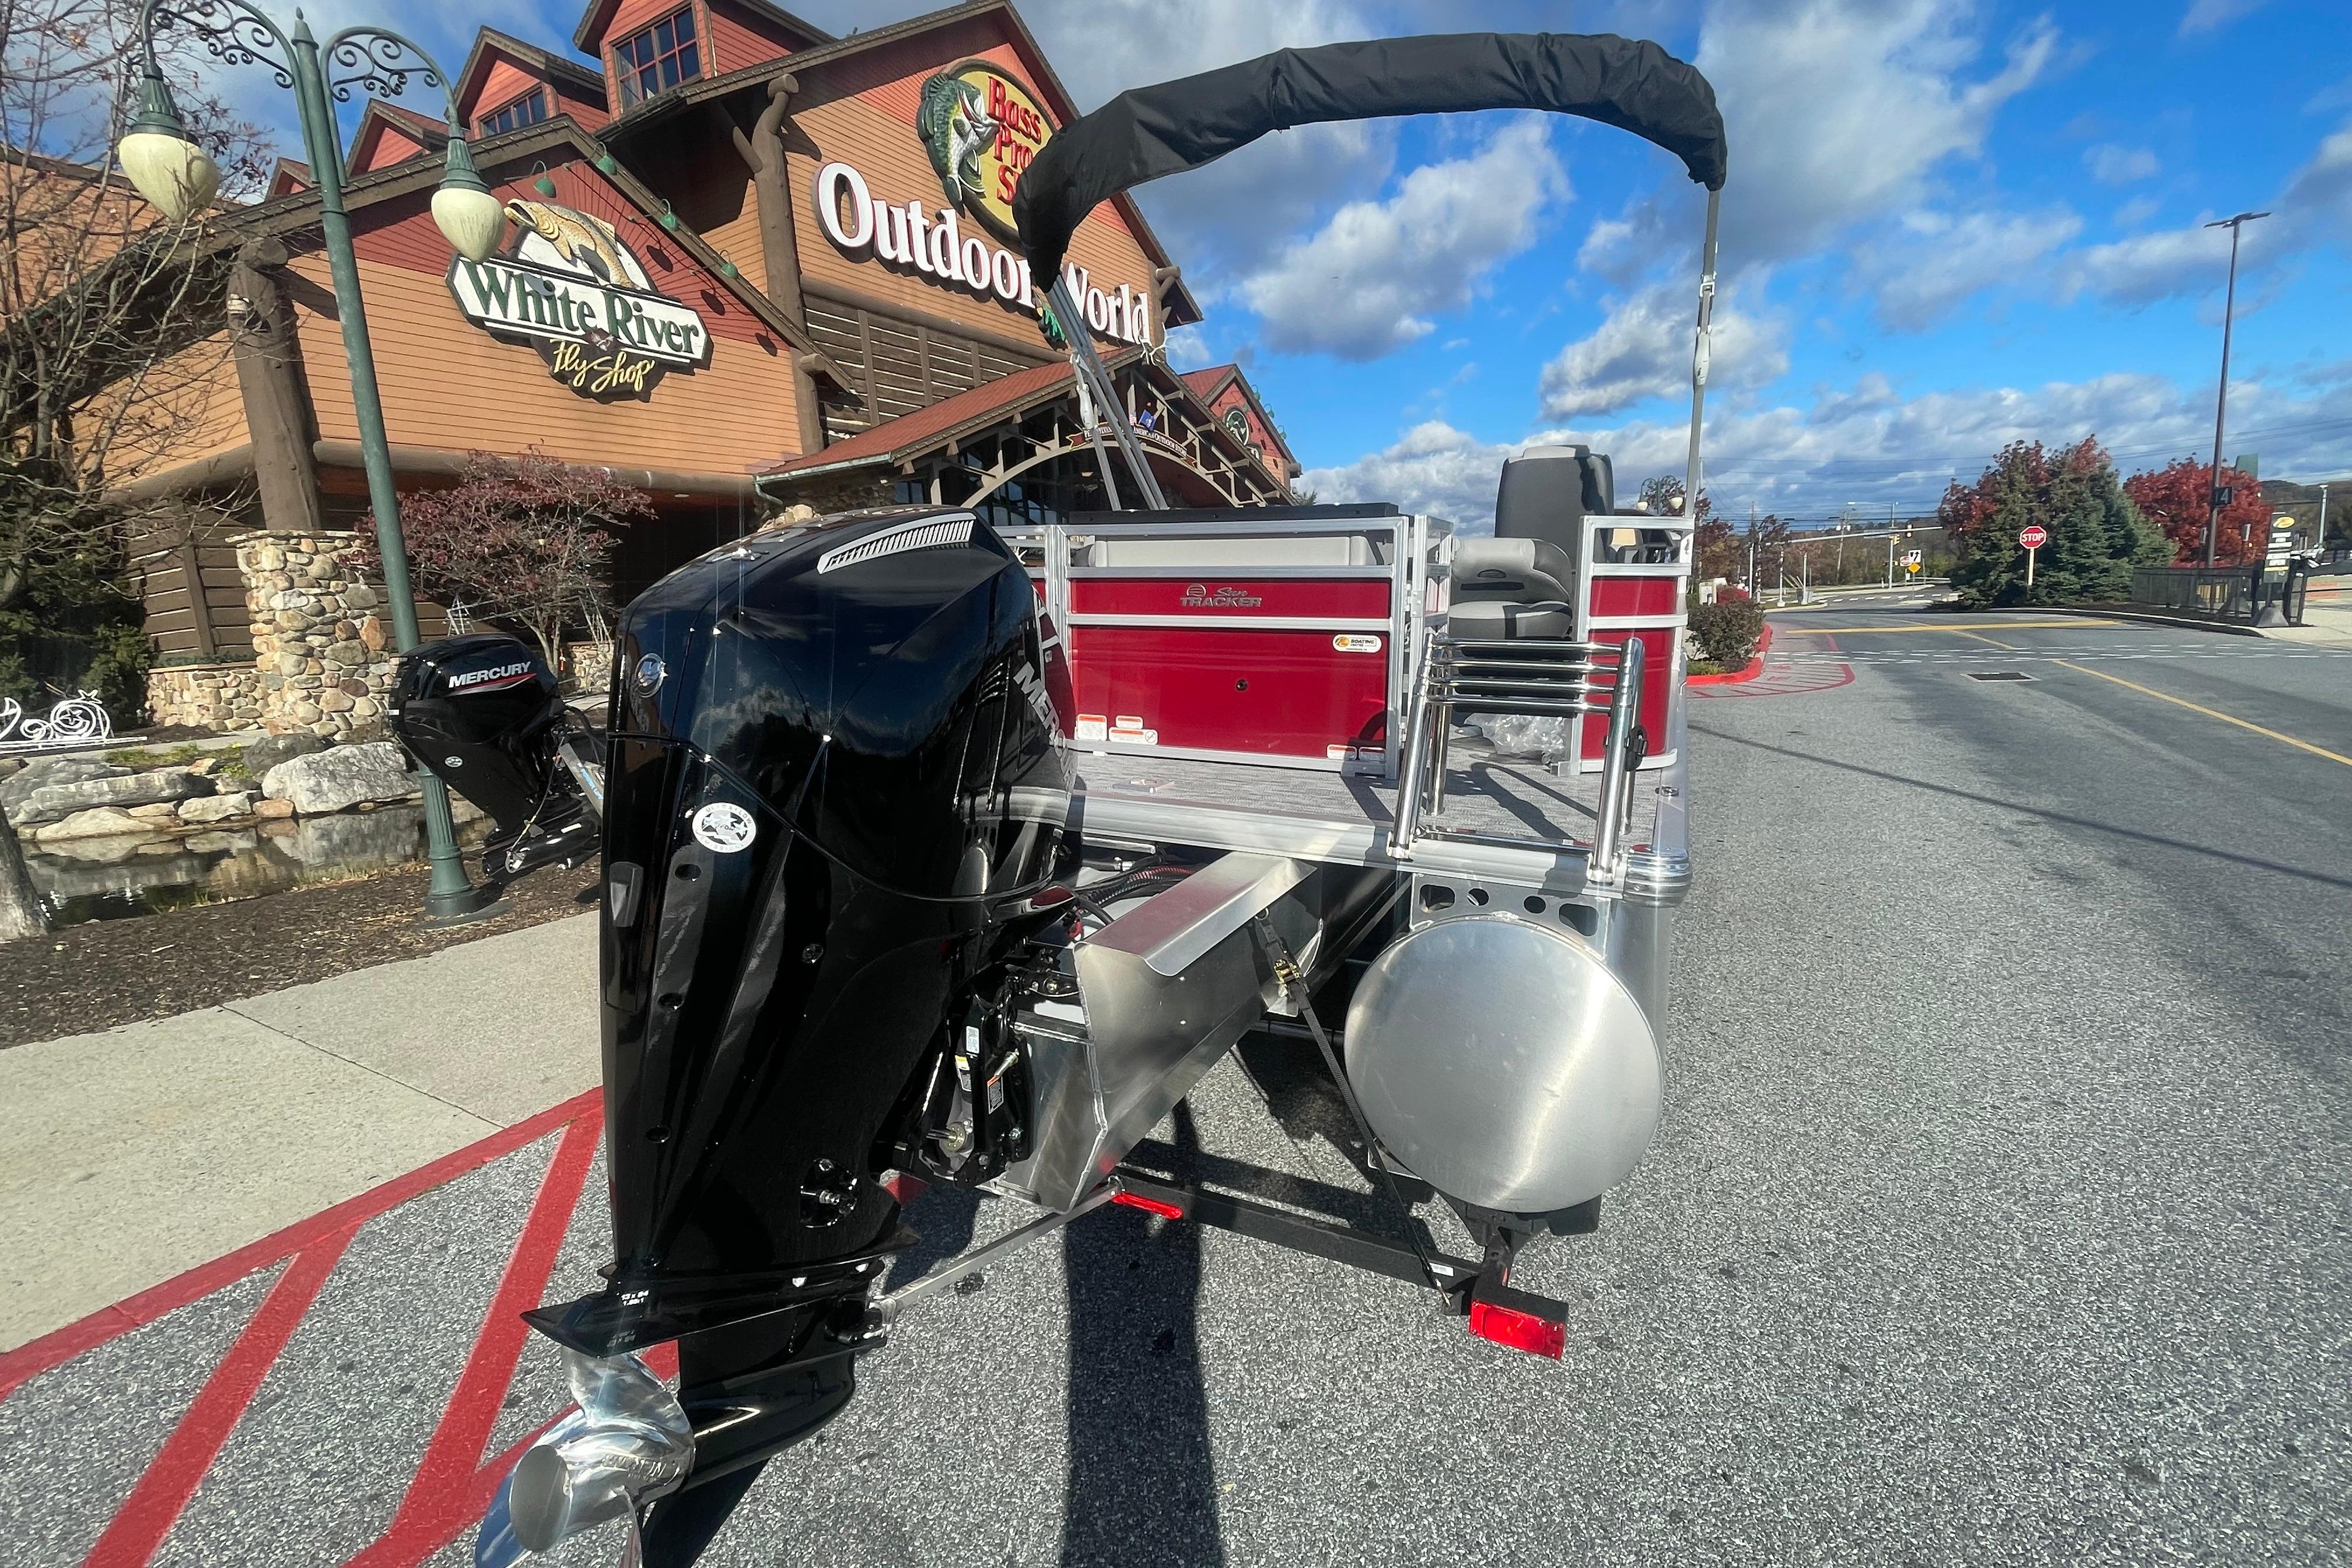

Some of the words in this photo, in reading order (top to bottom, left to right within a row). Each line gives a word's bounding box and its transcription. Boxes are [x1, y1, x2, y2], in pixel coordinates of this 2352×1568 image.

[988, 76, 1042, 145] Bass
[993, 124, 1034, 172] Pro
[464, 261, 597, 333] White
[604, 290, 698, 354] River
[549, 340, 596, 387] Fly
[591, 351, 655, 393] Shop
[2022, 533, 2044, 542] STOP
[1181, 597, 1262, 607] TRACKER
[449, 661, 531, 688] MERCURY
